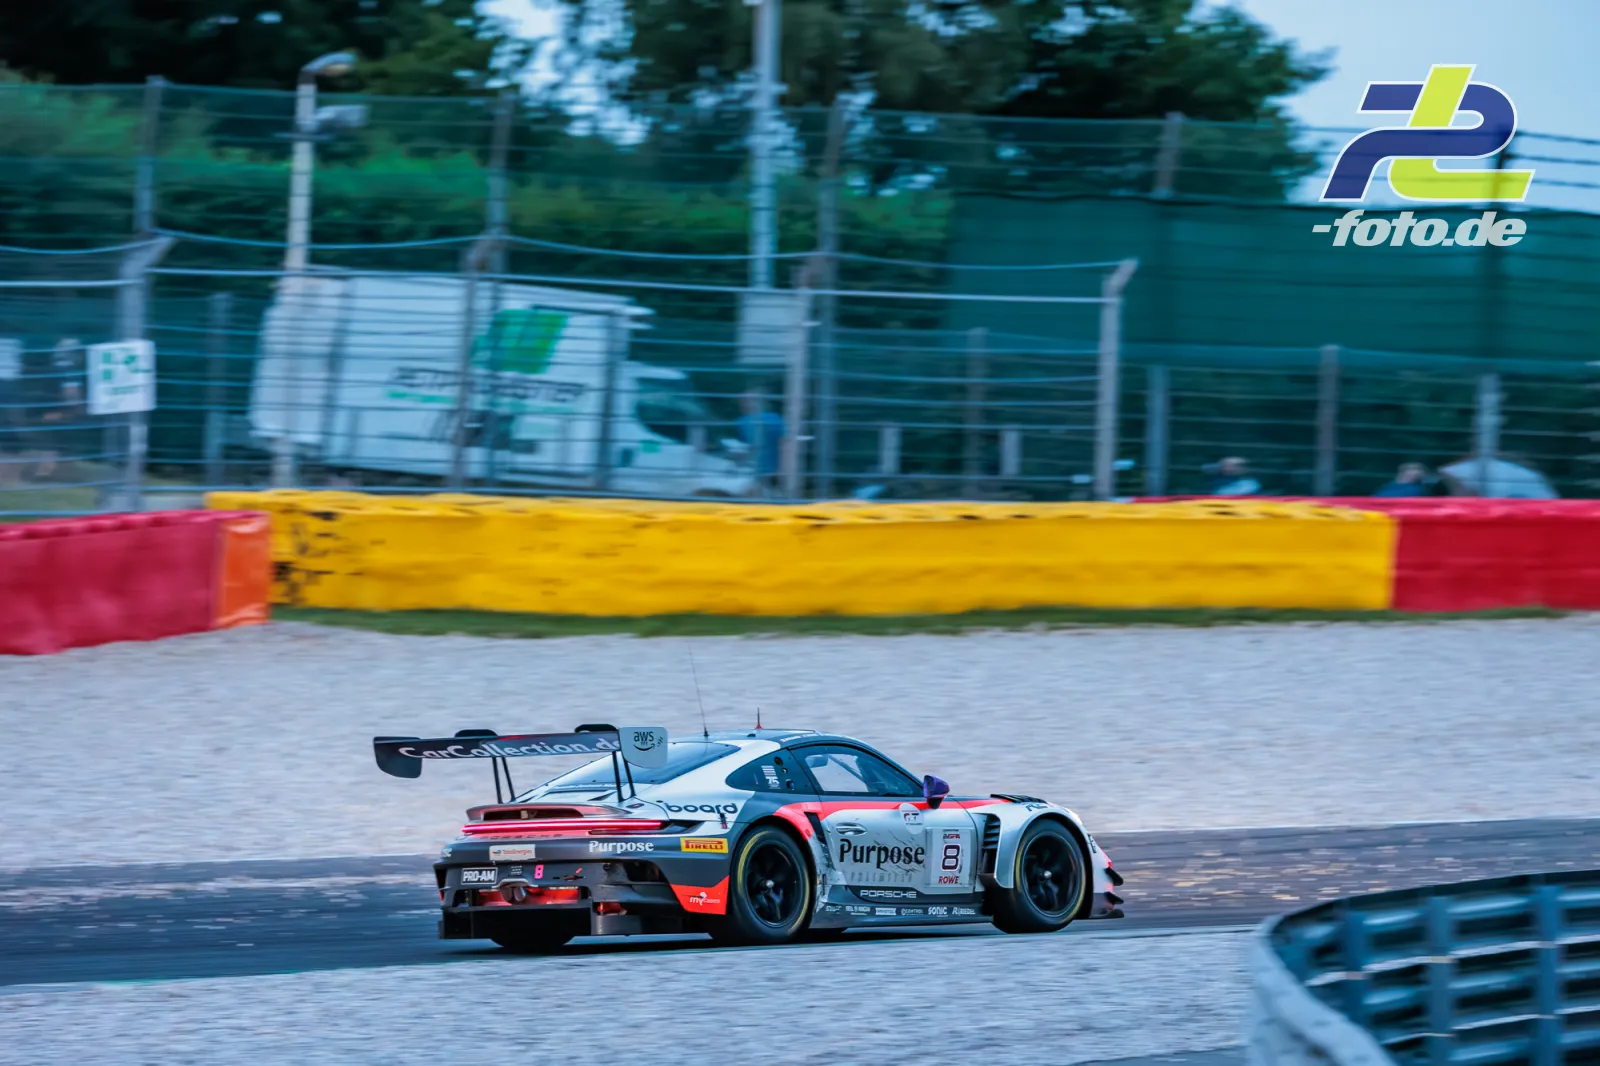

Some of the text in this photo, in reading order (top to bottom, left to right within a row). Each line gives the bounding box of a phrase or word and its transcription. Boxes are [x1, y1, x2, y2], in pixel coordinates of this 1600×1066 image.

[633, 731, 654, 742] aws
[663, 803, 738, 813] board
[588, 840, 654, 854] Purpose
[685, 840, 723, 850] PIRELLI
[839, 838, 925, 869] Purpose
[941, 843, 961, 872] 8
[462, 870, 496, 882] PRO-AM
[938, 875, 959, 885] ROWE
[859, 889, 917, 899] PORSCHE
